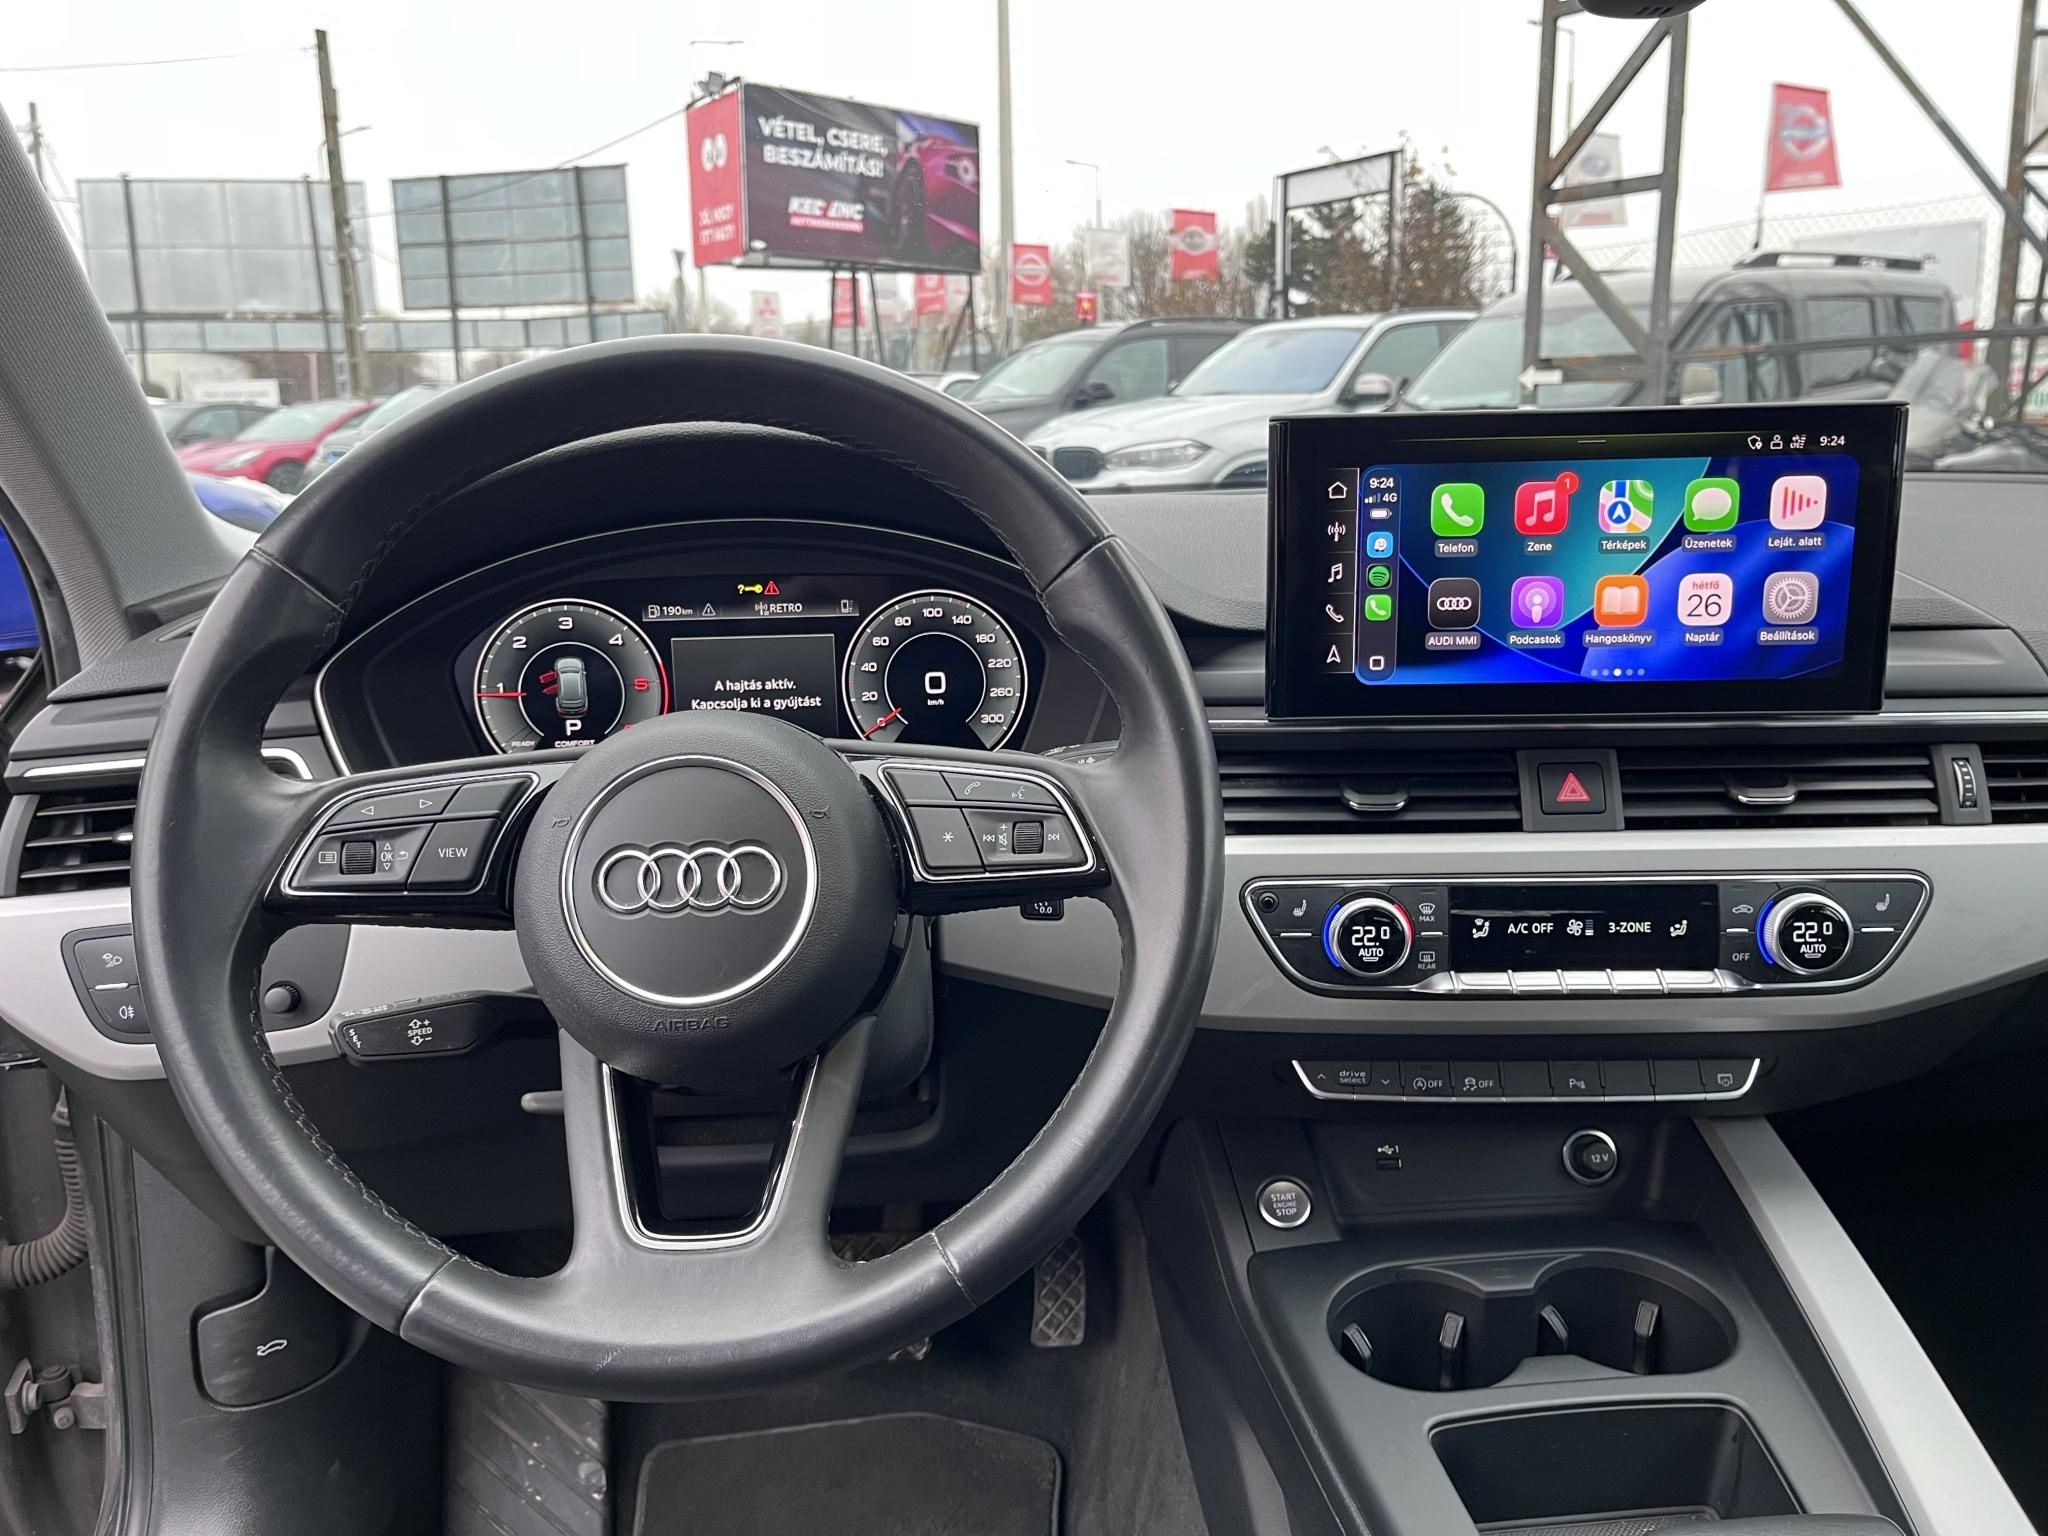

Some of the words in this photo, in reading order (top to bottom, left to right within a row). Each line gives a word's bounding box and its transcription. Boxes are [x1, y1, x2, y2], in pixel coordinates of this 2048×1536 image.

[758, 115, 825, 145] VÉTEL,
[826, 127, 889, 157] CSERE,
[762, 143, 885, 178] BESZÁMÍTÁS!
[1820, 435, 1845, 447] 9:24
[1369, 477, 1395, 489] 9:24
[1564, 478, 1571, 489] 1
[1382, 493, 1398, 503] 4G
[1527, 541, 1552, 552] Zene
[1601, 539, 1647, 552] Térképek
[1685, 537, 1733, 549] Üzenetek
[1768, 536, 1796, 549] Leját.
[1798, 535, 1822, 547] alatt
[1438, 543, 1475, 553] Telefon
[1692, 580, 1721, 590] hétfő
[770, 602, 803, 613] RETRO
[1687, 593, 1722, 617] 26
[922, 607, 943, 618] 100
[558, 616, 574, 630] 3
[894, 616, 912, 627] 80
[951, 615, 972, 625] 140
[608, 633, 624, 646] 4
[975, 633, 996, 644] 180
[1428, 635, 1454, 646] AUDI
[1456, 635, 1478, 646] MMI
[1509, 634, 1562, 645] Podcastok
[1585, 632, 1653, 645] Hangoskönyv
[1685, 631, 1721, 643] Naptár
[1760, 629, 1816, 642] Beállítások
[512, 636, 527, 649] 2
[872, 636, 890, 647] 60
[860, 661, 878, 672] 40
[987, 658, 1012, 669] 220
[714, 680, 725, 692] A
[725, 678, 763, 694] hajtás
[765, 677, 797, 691] aktív.
[924, 671, 947, 694] 0
[496, 682, 504, 695] 1
[989, 687, 1014, 698] 260
[861, 690, 879, 702] 20
[691, 699, 748, 711] Kapcsolja
[750, 699, 761, 709] ki
[764, 701, 772, 709] a
[773, 695, 822, 711] gyújtást
[980, 713, 1005, 724] 300
[565, 719, 582, 736] P
[554, 738, 596, 748] COMFORT
[380, 851, 394, 862] OK
[438, 847, 468, 858] VIEW
[1418, 915, 1435, 923] MAX
[1507, 922, 1529, 935] A/C
[1532, 922, 1554, 934] OFF
[1608, 921, 1652, 934] 3-ZONE
[1358, 947, 1384, 957] AUTO
[1800, 943, 1827, 954] AUTO
[1732, 952, 1750, 962] OFF
[1417, 962, 1436, 970] REAR
[652, 1016, 730, 1032] AIRBAG
[407, 1026, 433, 1038] SPEED
[349, 1028, 362, 1049] SET
[1339, 1069, 1367, 1078] drive
[1339, 1076, 1367, 1085] select
[1427, 1079, 1444, 1089] OFF
[1478, 1079, 1495, 1089] OFF
[1590, 1153, 1601, 1163] 12
[1601, 1152, 1609, 1162] V
[1270, 1192, 1297, 1202] START
[1275, 1207, 1298, 1217] STOP
